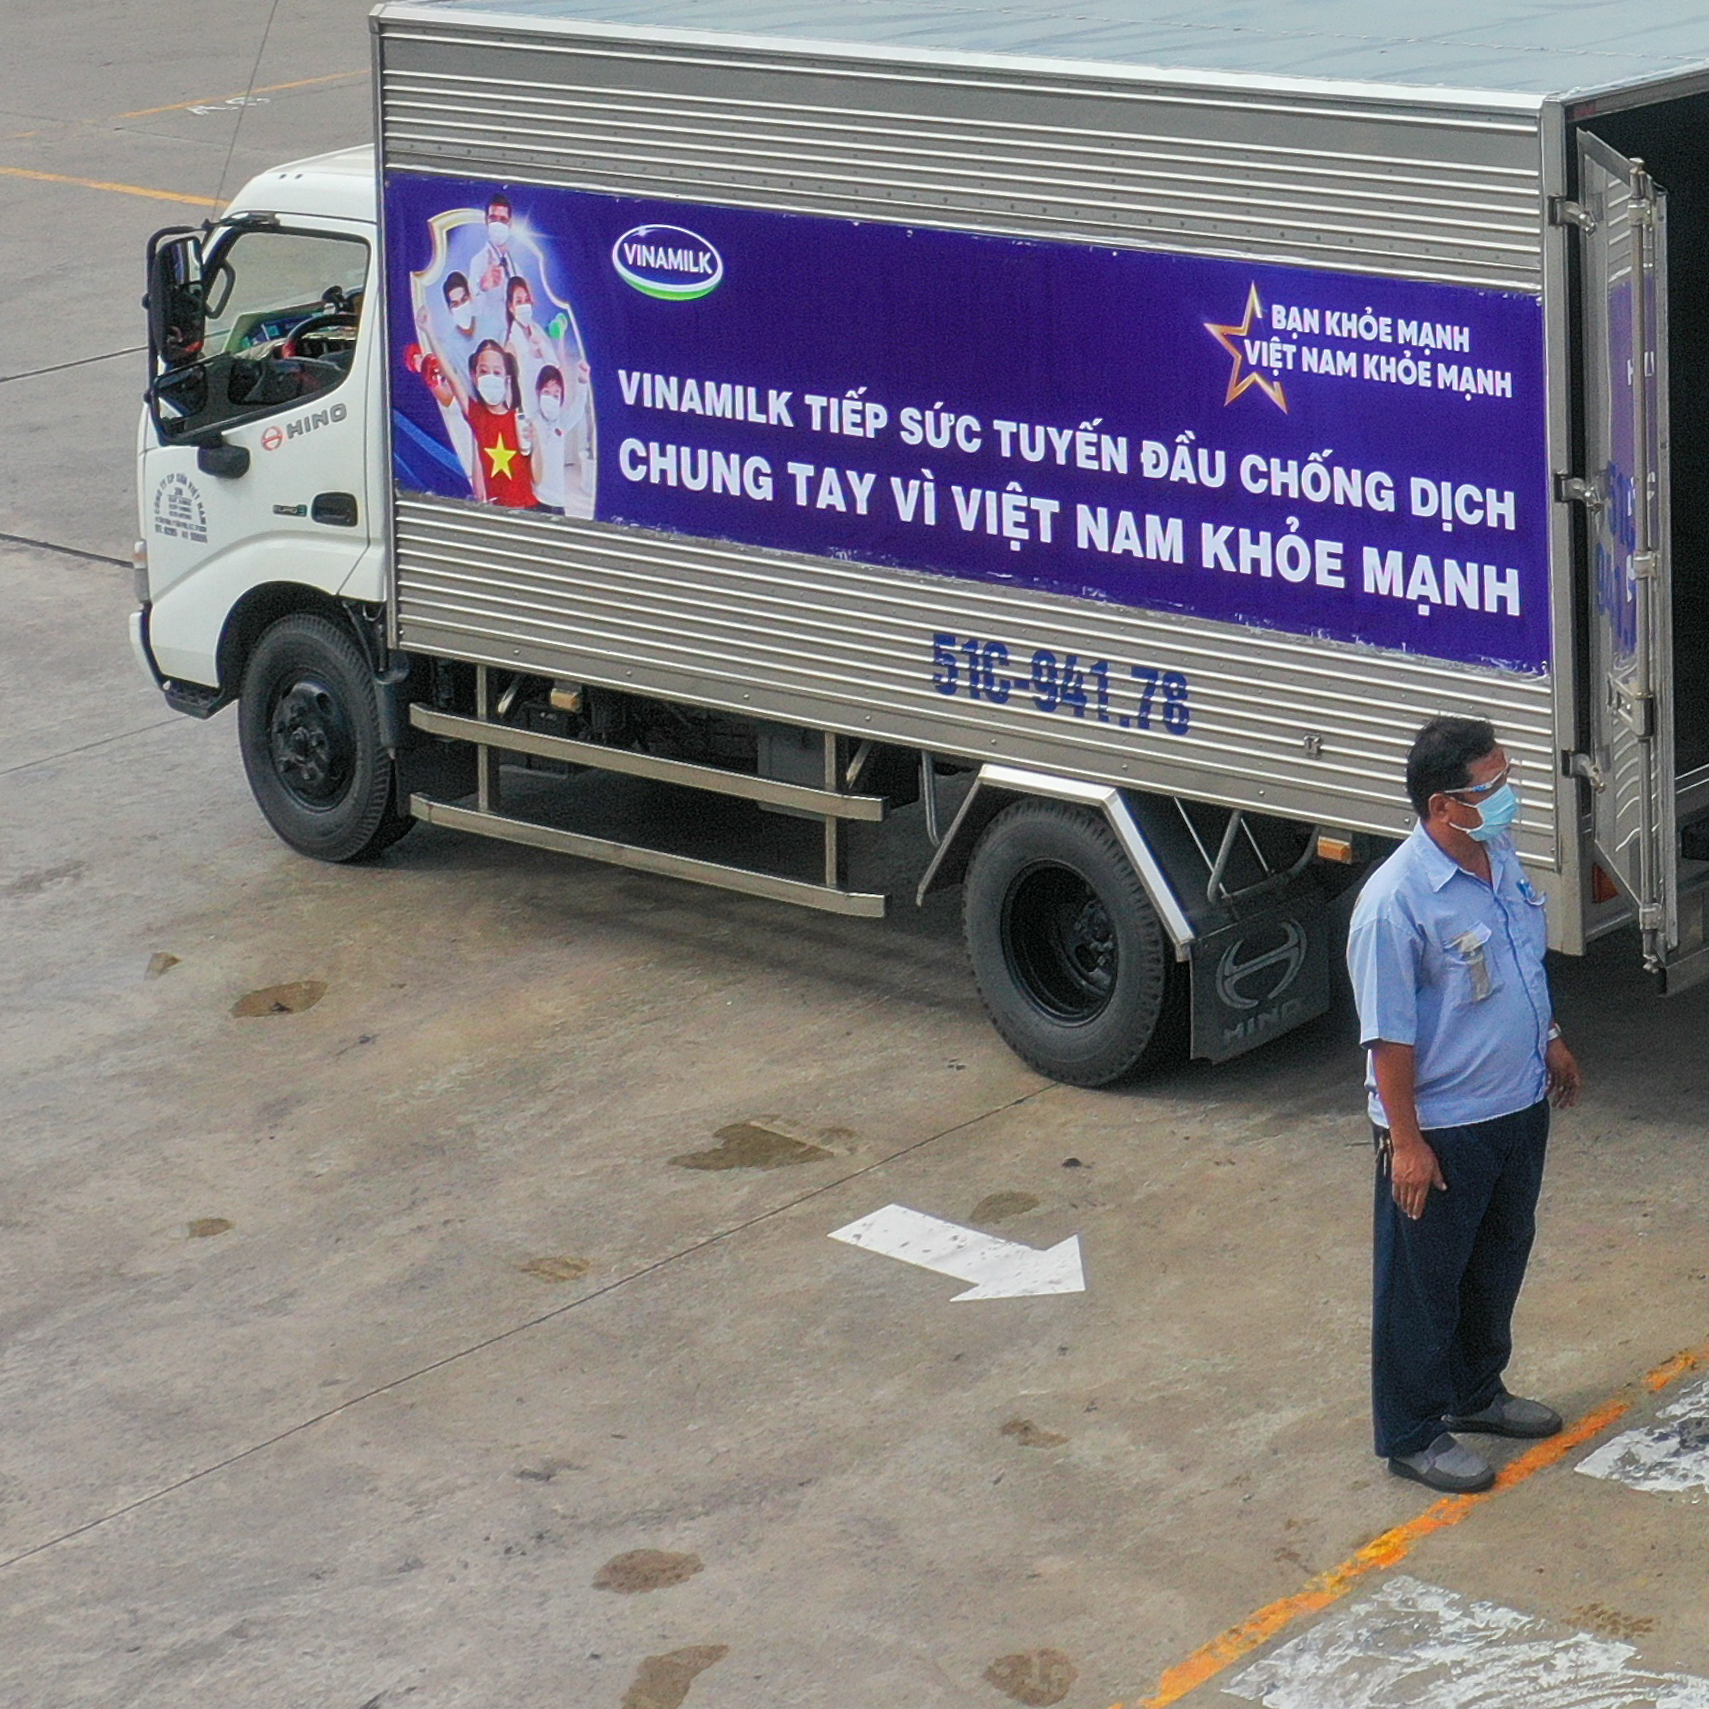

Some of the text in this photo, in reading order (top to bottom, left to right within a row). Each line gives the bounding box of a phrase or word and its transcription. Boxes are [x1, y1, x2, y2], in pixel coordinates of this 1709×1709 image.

[623, 242, 713, 275] VINAMILK
[1271, 304, 1470, 356] BẠN KHỎE MẠNH
[1243, 336, 1513, 402] VIỆT NAM KHỎE MẠNH
[286, 402, 349, 440] HINO
[617, 369, 1517, 533] VINAMILK TIẾP SỨC TUYẾN ĐẦU CHỐNG DỊCH
[618, 437, 1521, 617] CHUNG TAY VÌ VIỆT NAM KHỎE MẠNH
[932, 632, 1191, 736] 51C-941.78
